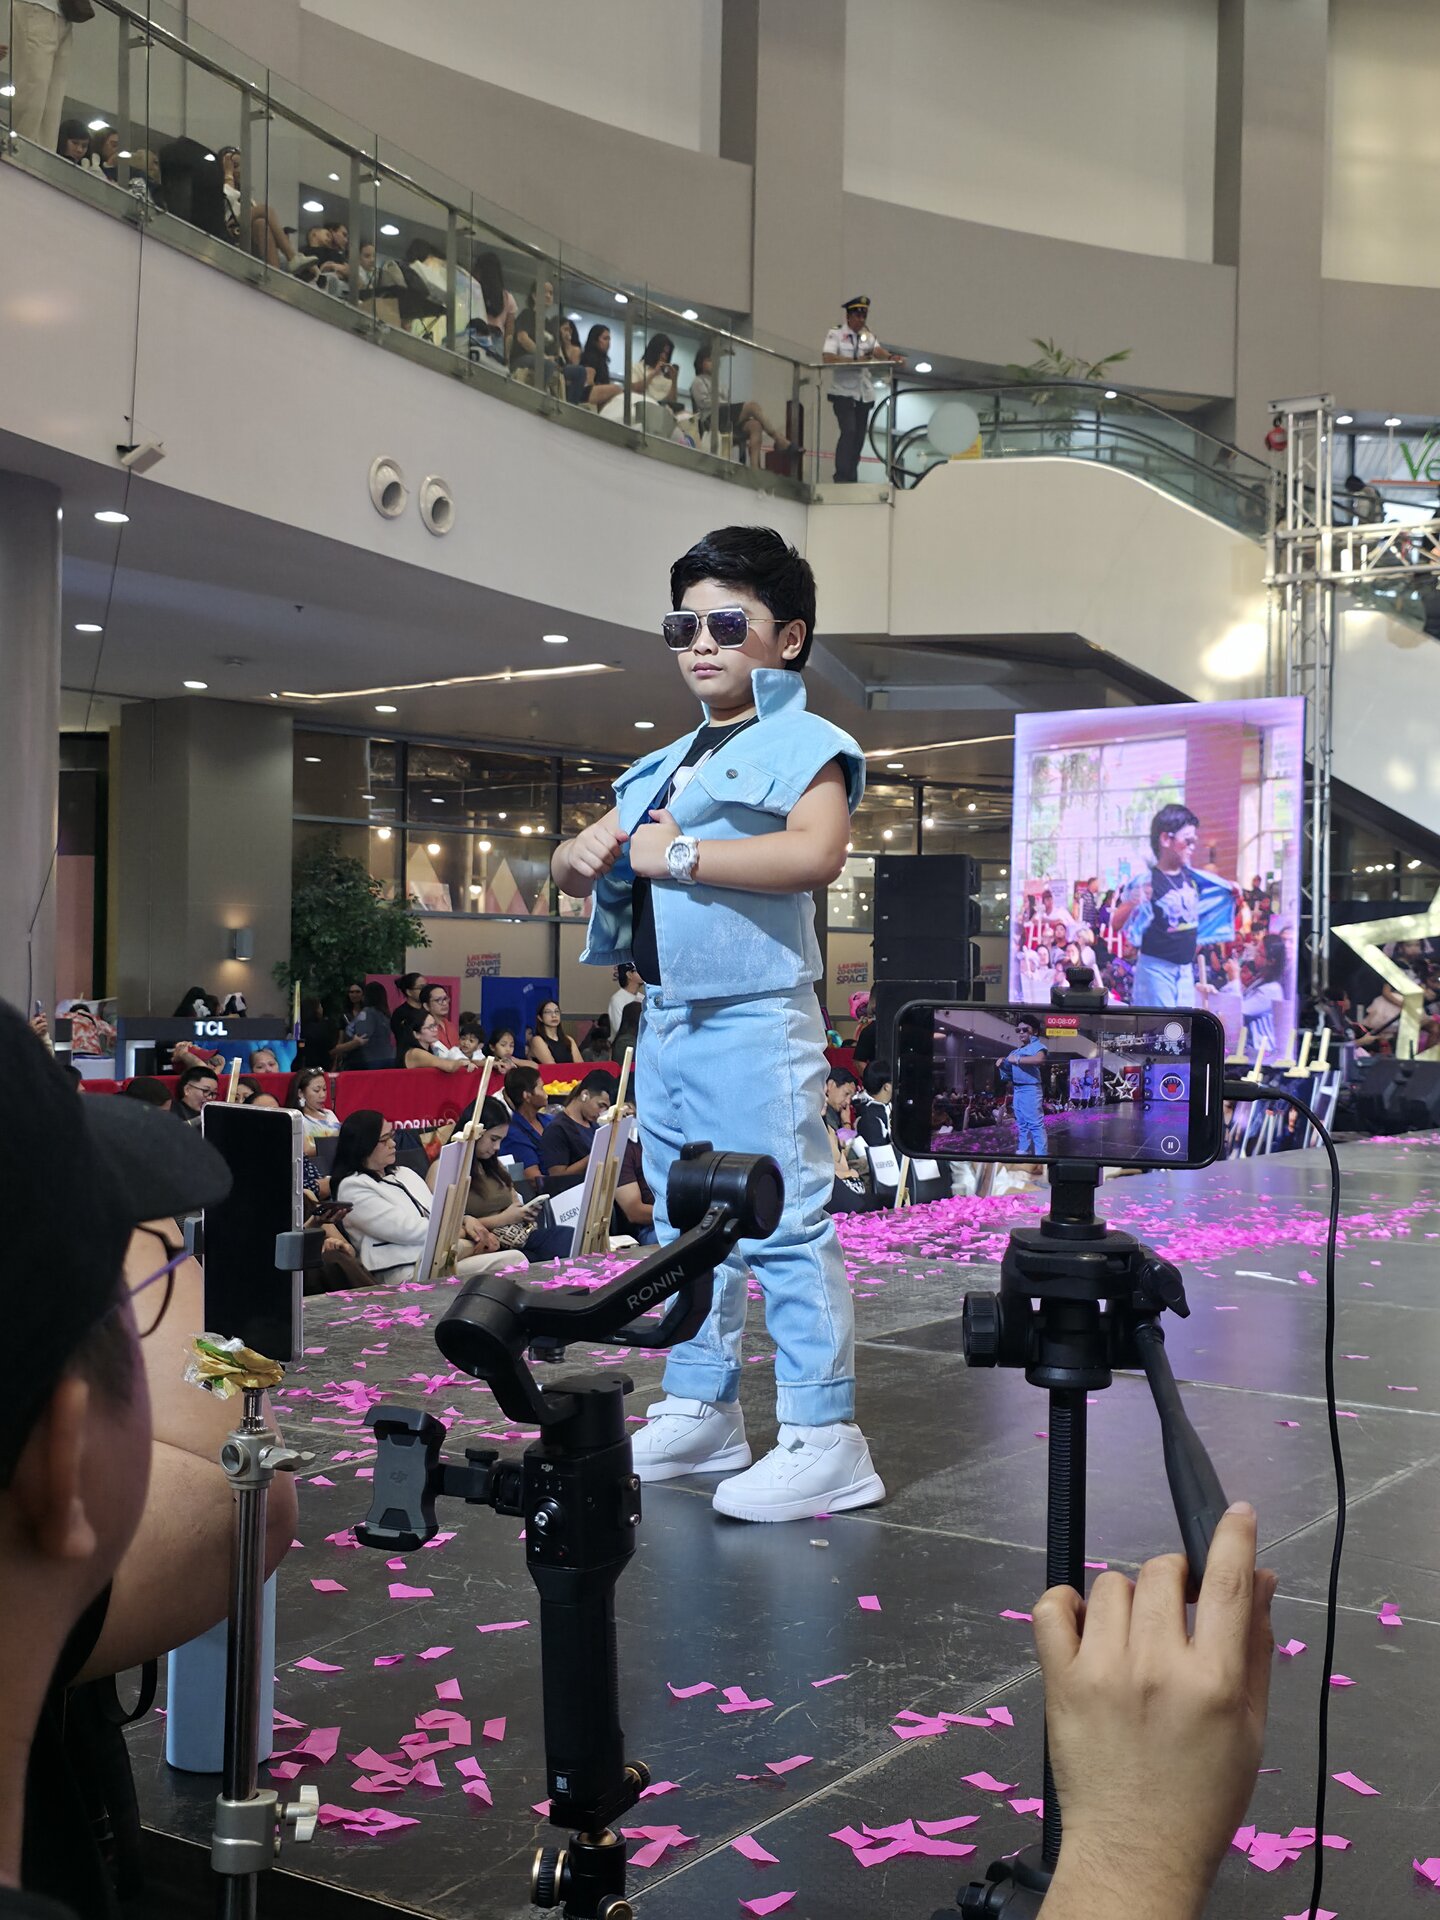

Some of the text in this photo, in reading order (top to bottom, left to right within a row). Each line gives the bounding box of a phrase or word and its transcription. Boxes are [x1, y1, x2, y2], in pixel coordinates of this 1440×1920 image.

[465, 966, 501, 978] SPACE
[836, 974, 868, 985] SPACE
[194, 1020, 228, 1036] TCL
[627, 1265, 684, 1310] RONIN
